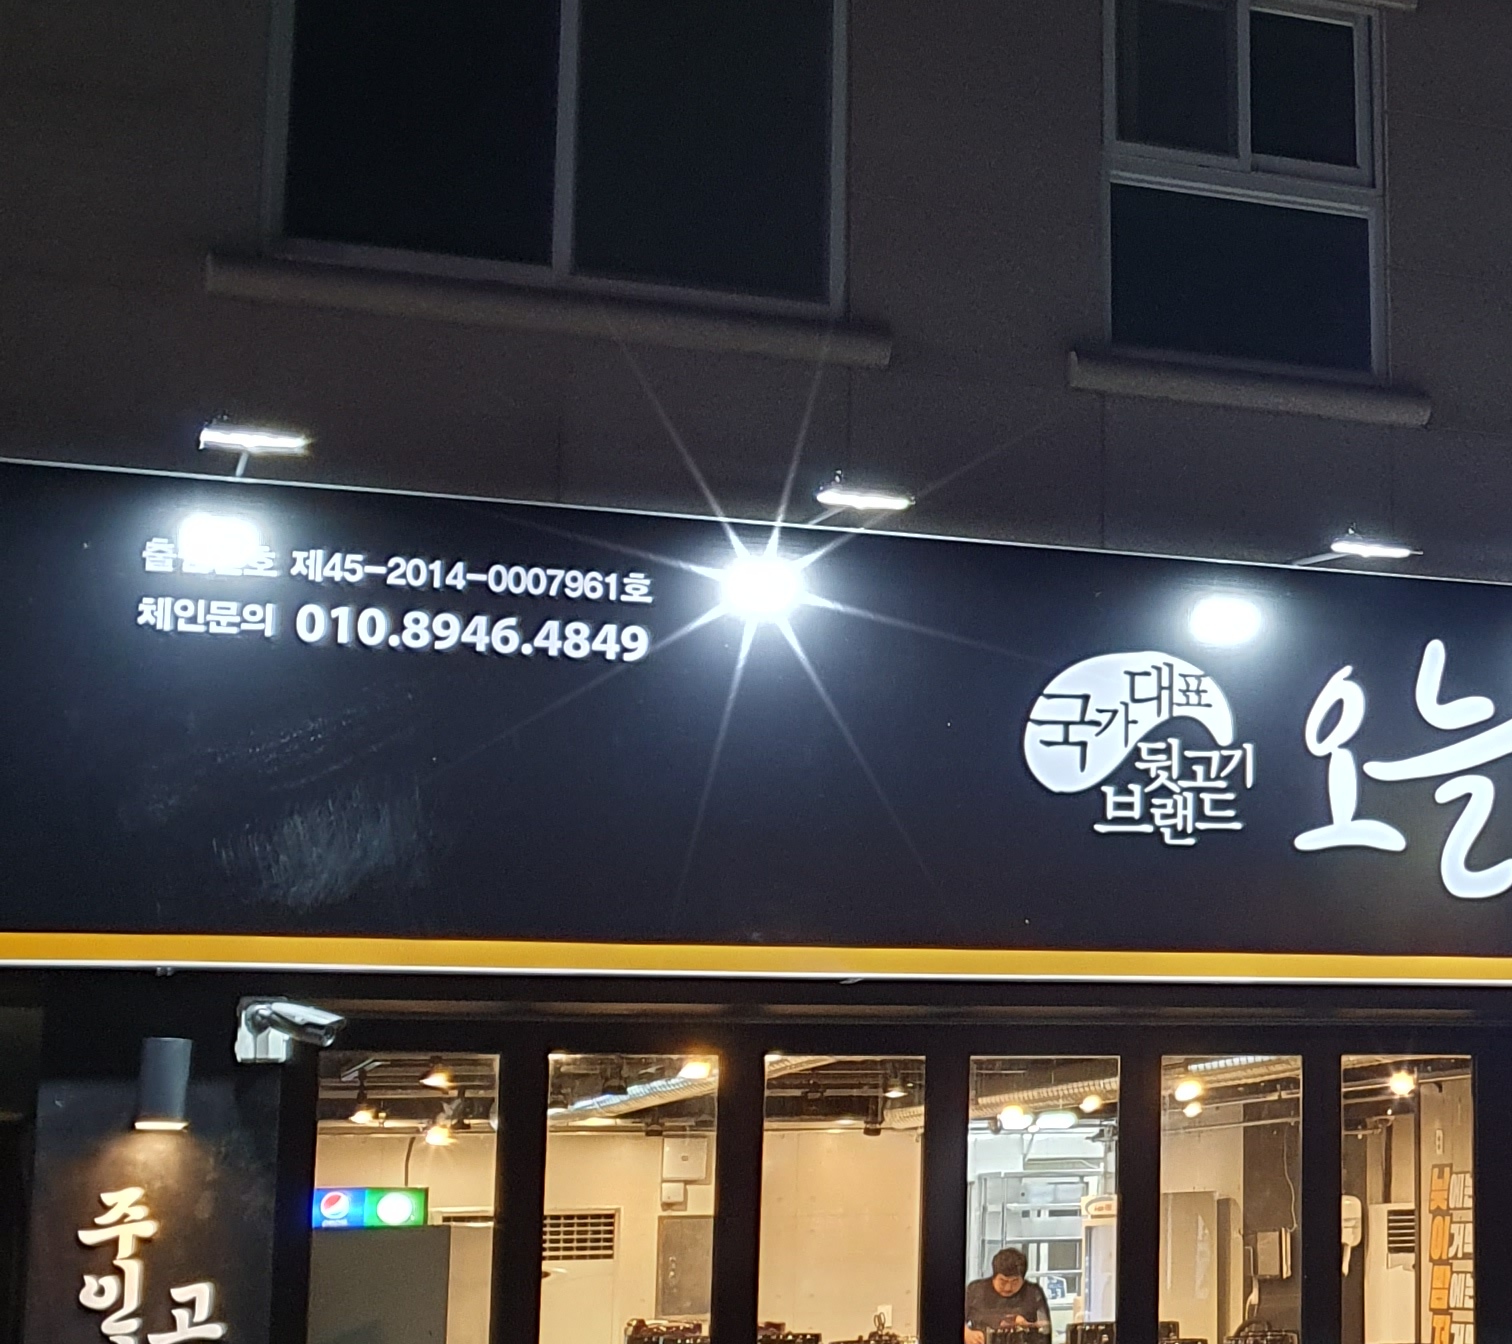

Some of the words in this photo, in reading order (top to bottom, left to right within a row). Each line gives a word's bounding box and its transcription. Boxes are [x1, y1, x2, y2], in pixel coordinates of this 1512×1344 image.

[142, 537, 279, 577] 출호
[137, 596, 276, 638] 체인문의
[295, 603, 650, 662] 010.8946.4849
[1134, 738, 1255, 793] 뒷고기
[1093, 784, 1244, 846] 브랜드
